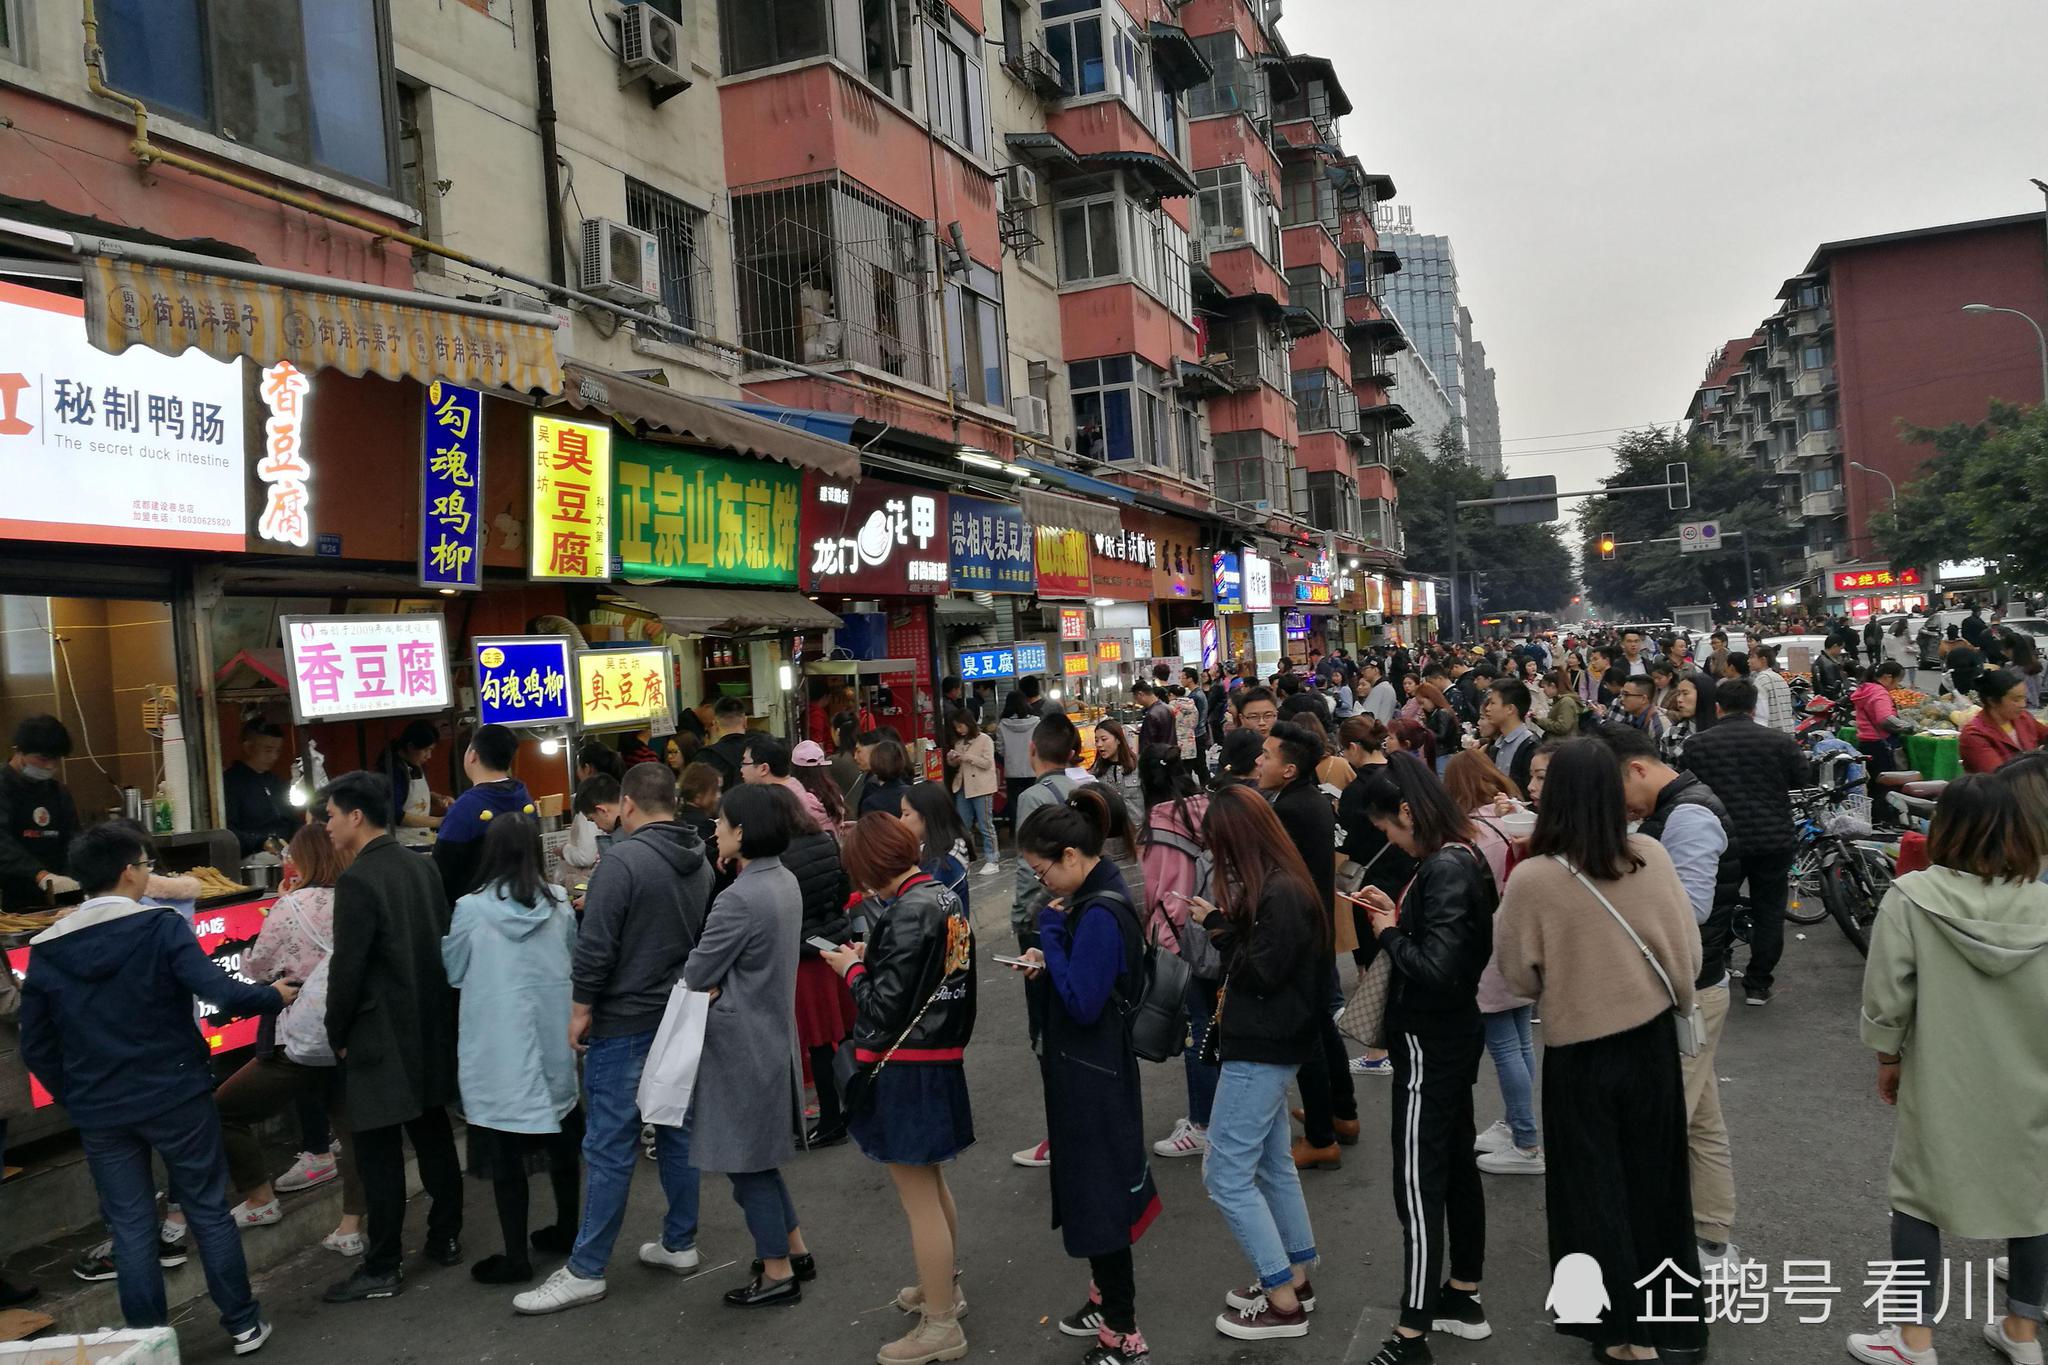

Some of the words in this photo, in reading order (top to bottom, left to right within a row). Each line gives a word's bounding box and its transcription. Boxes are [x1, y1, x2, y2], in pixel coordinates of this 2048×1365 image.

[54, 377, 225, 446] 秘制鸭肠
[54, 433, 83, 451] The
[89, 439, 134, 457] secret
[139, 444, 171, 462] duck
[176, 449, 231, 469] intestine
[265, 360, 305, 540] 香豆腐
[536, 424, 550, 493] 吴氏坊
[429, 394, 475, 582] 勾魂鸡柳
[549, 427, 593, 576] 臭豆腐
[619, 460, 798, 572] 正宗山东煎饼
[298, 639, 438, 705] 香豆腐
[480, 665, 564, 710] 勾魂鸡柳
[484, 652, 502, 665] 正宗
[584, 669, 664, 712] 臭豆腐
[962, 652, 1015, 677] 臭豆腐
[195, 916, 226, 938] 小吃
